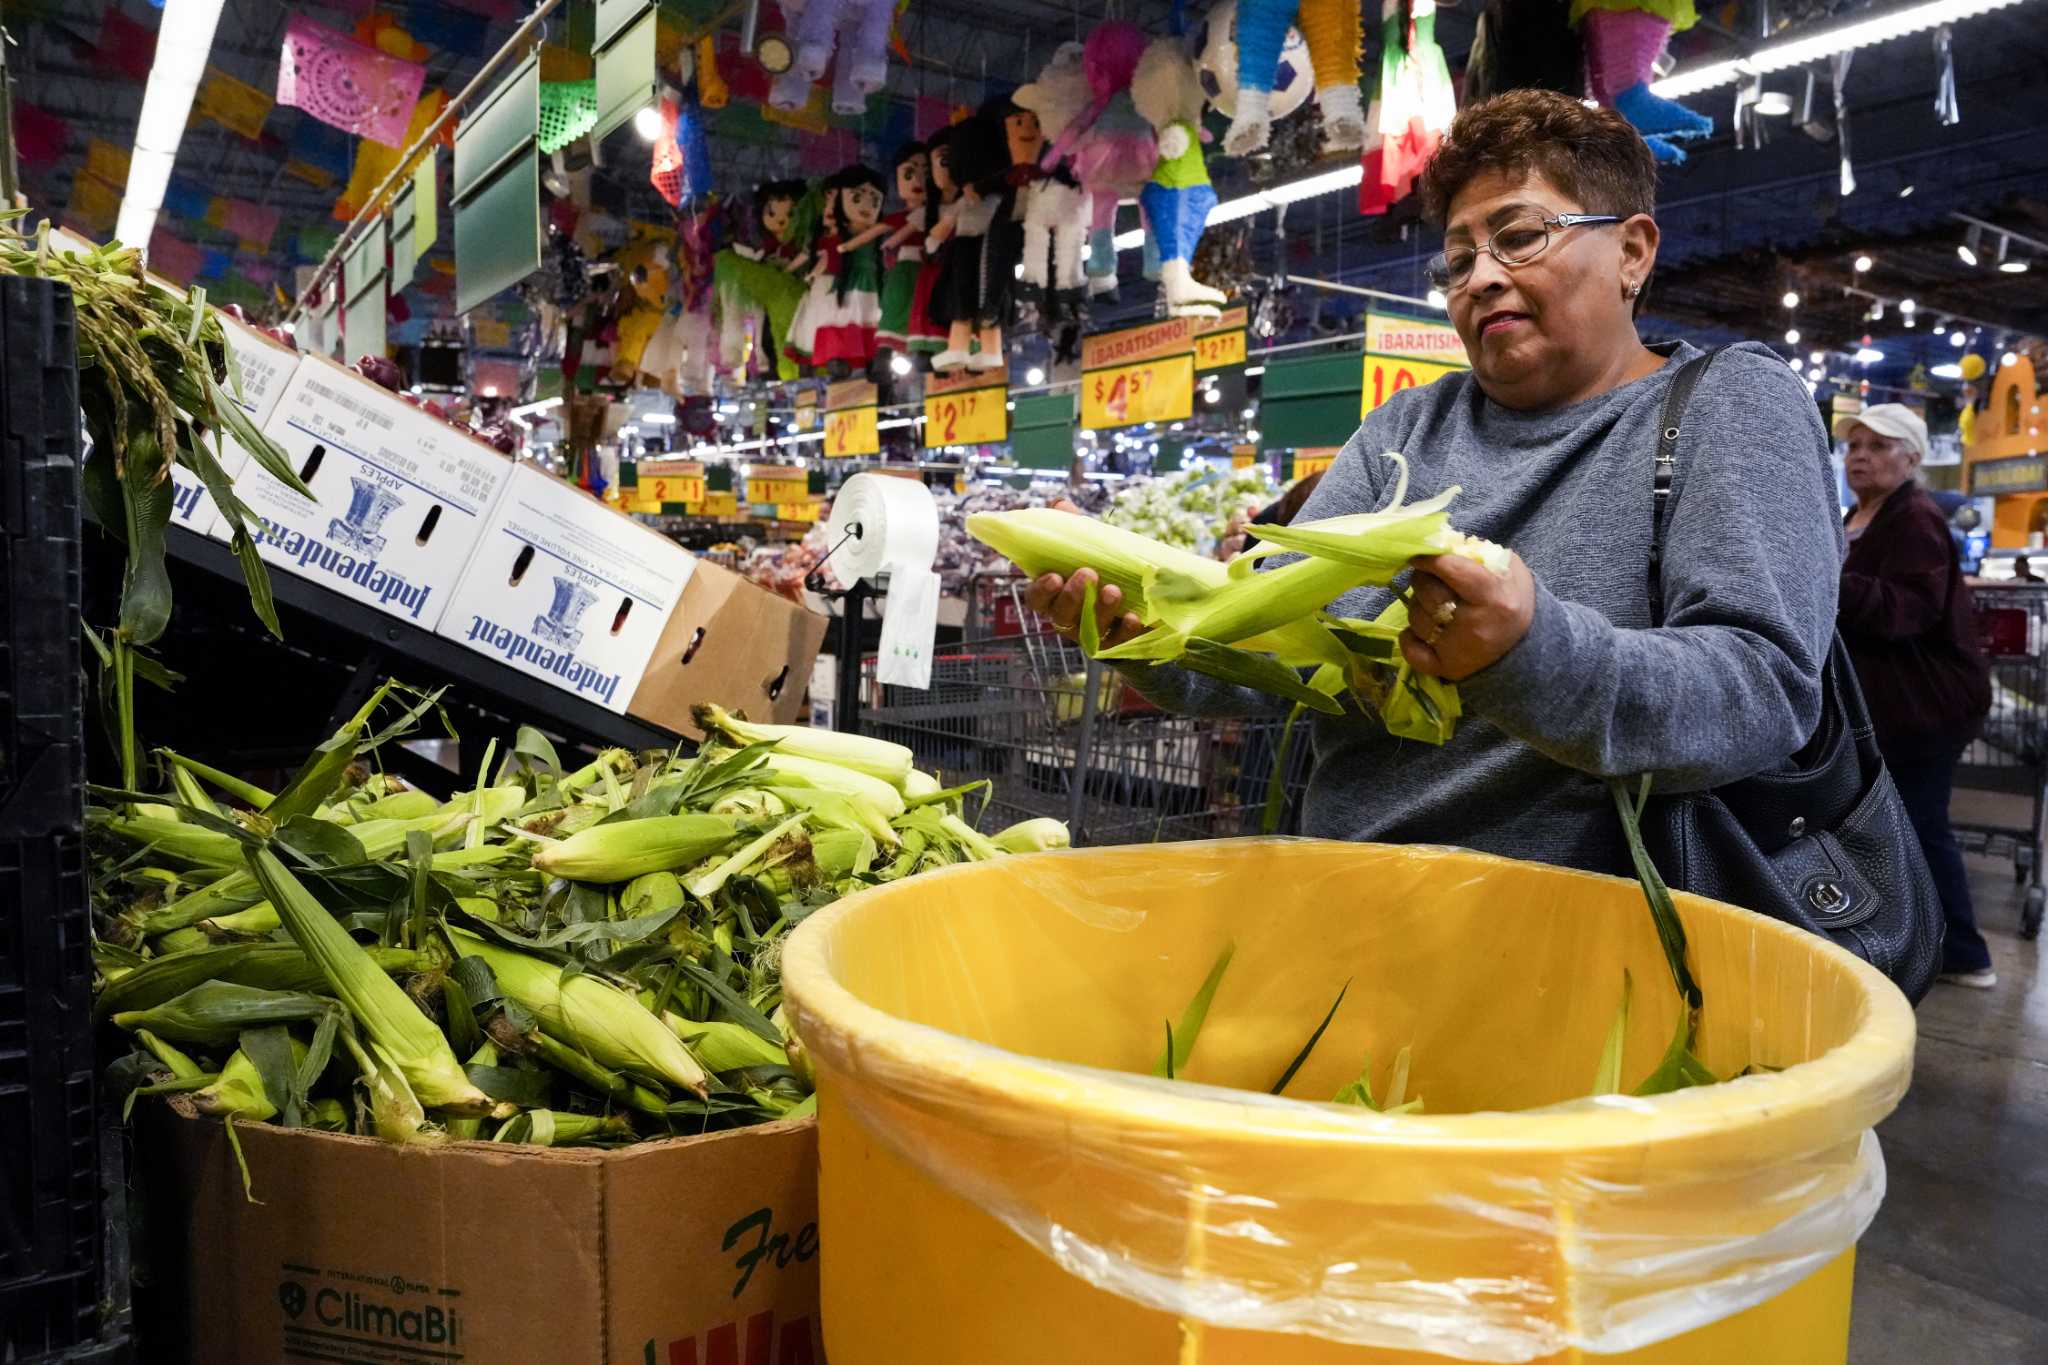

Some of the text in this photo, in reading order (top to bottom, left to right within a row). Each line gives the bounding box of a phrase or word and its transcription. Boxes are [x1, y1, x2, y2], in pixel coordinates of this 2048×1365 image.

[360, 464, 404, 491] APPLES
[252, 516, 432, 619] Independent
[564, 564, 601, 588] APPLES
[465, 615, 621, 704] Independent
